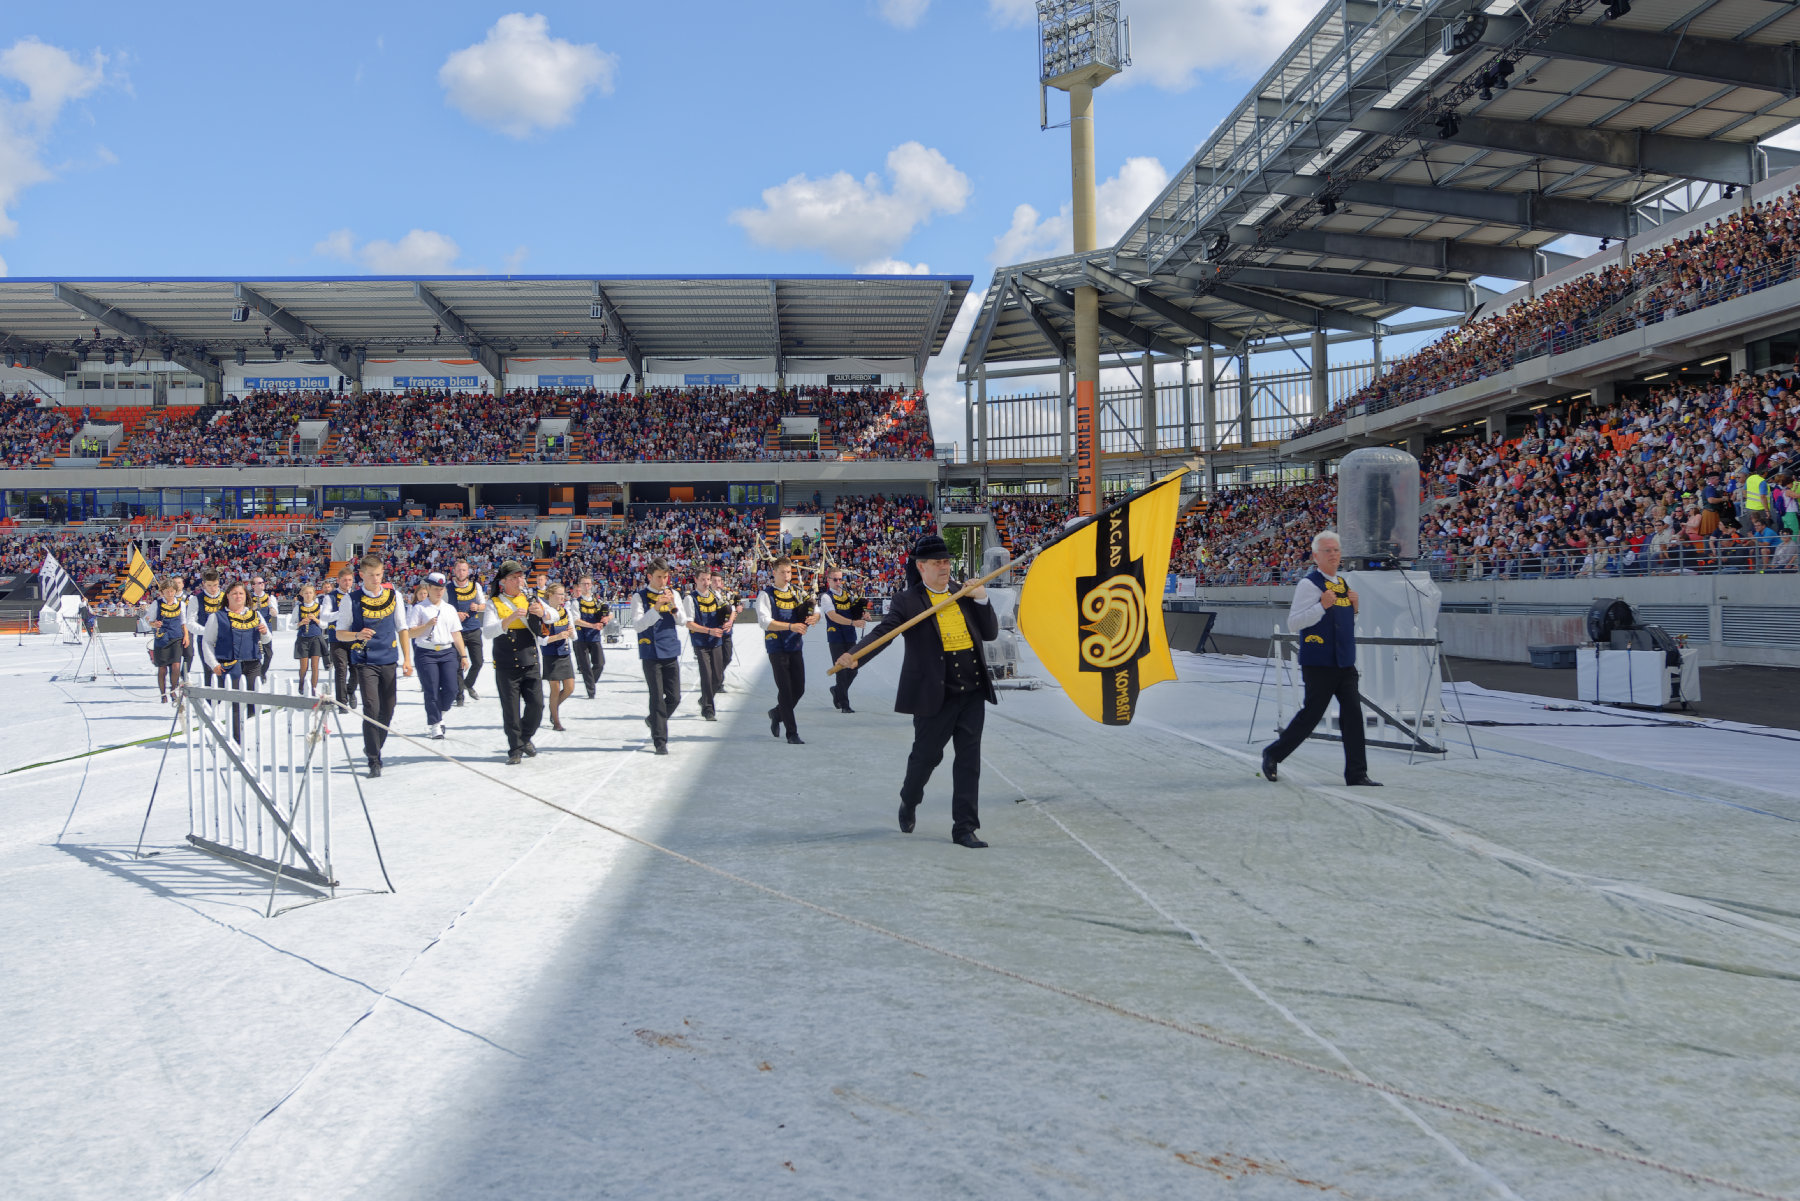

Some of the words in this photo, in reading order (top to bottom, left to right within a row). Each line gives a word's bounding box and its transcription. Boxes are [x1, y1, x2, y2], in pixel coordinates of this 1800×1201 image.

[259, 378, 296, 388] france
[300, 377, 325, 388] bleu
[408, 377, 446, 387] france
[449, 376, 474, 387] bleu
